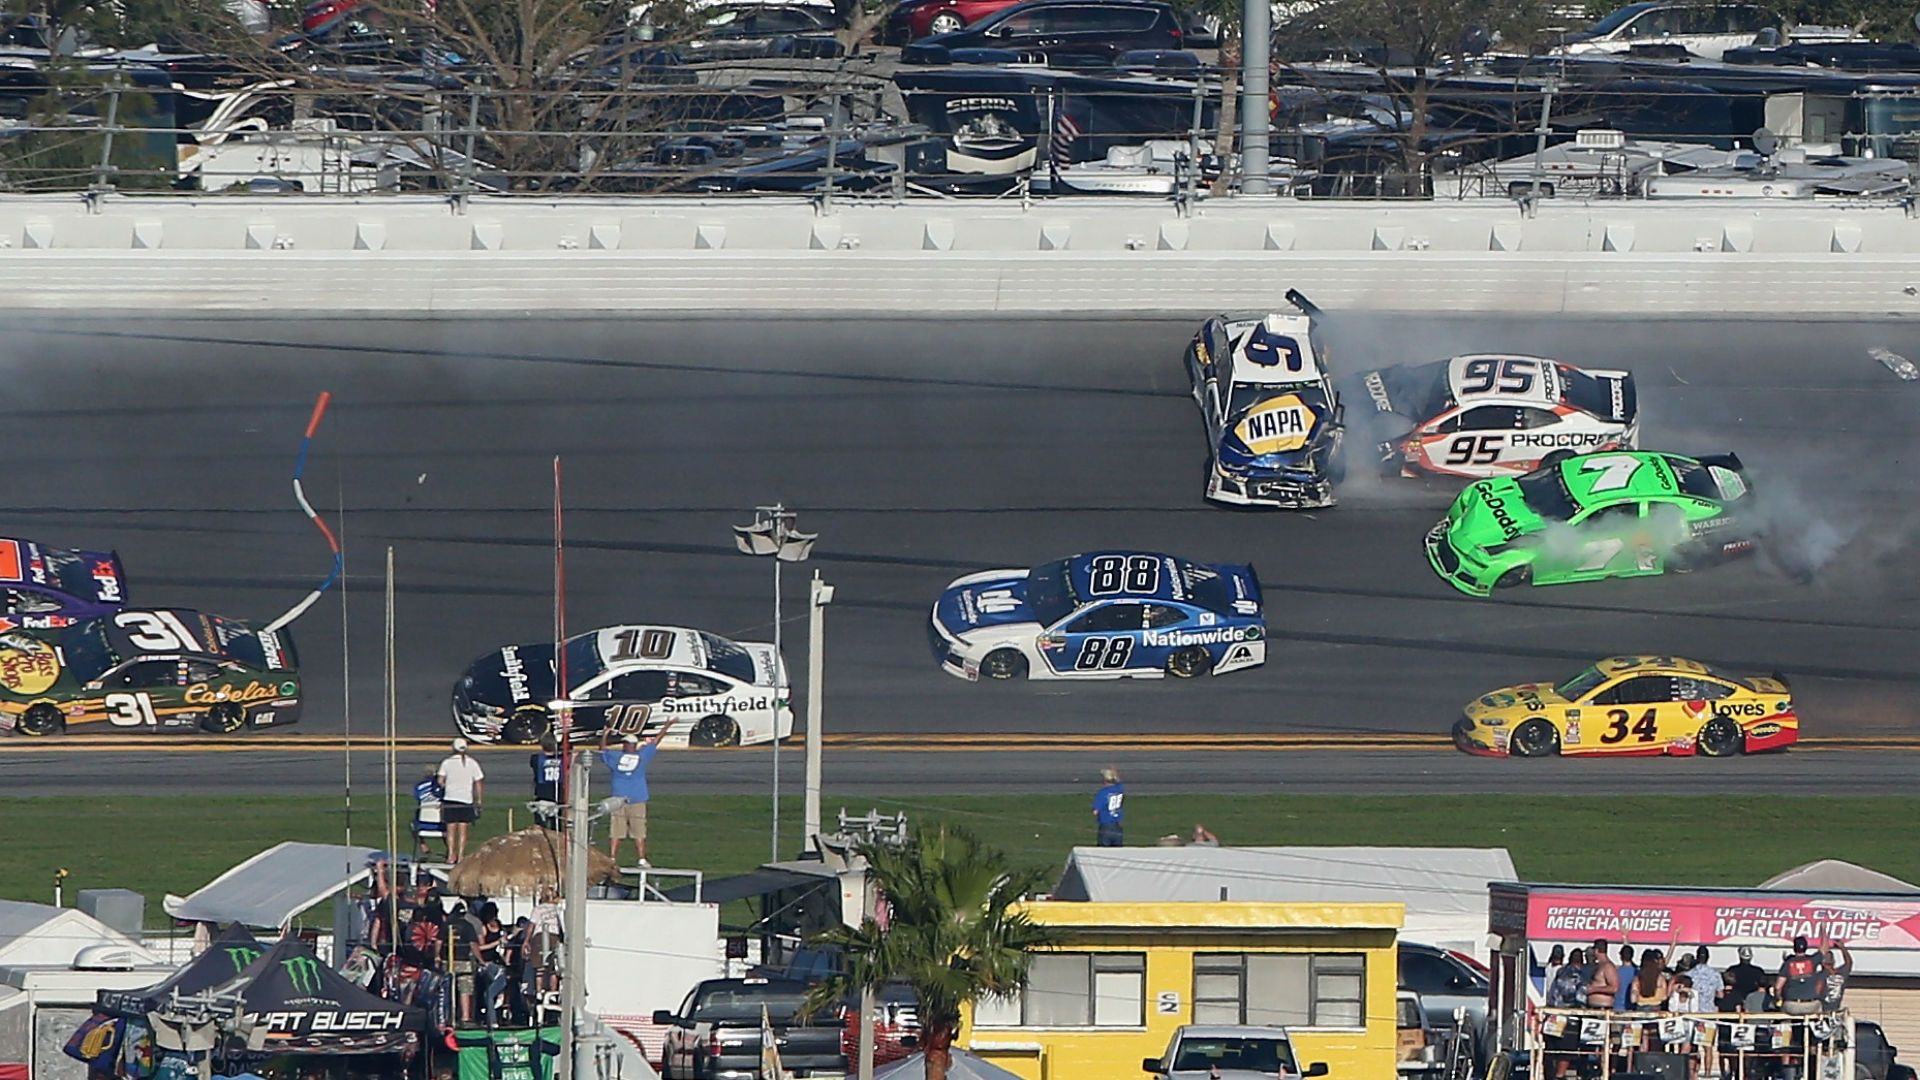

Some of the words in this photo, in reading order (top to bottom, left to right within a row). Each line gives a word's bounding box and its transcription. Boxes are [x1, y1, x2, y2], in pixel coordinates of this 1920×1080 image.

[946, 97, 1019, 114] SIERRA
[1462, 359, 1536, 395] 95
[1248, 408, 1304, 441] NAPA
[1446, 435, 1505, 466] 95
[1580, 454, 1643, 495] 7
[1475, 481, 1523, 542] GoDaddy
[1575, 536, 1623, 573] 7
[91, 560, 122, 602] FedEx
[1089, 554, 1161, 596] 88
[22, 615, 69, 629] FedEx
[113, 610, 204, 653] 31
[610, 628, 678, 664] 10
[1142, 626, 1245, 647] Nationwide
[16, 653, 36, 674] Pro
[34, 652, 55, 677] Bass
[1074, 634, 1135, 671] 88
[0, 656, 24, 690] Shops
[499, 644, 531, 704] Smithfield
[183, 680, 279, 704] Cabela's
[105, 691, 158, 727] 31
[661, 695, 768, 715] Smithfield
[254, 712, 276, 725] CAT
[604, 702, 651, 736] 10
[1599, 707, 1659, 745] 34
[617, 753, 640, 773] 9
[1545, 914, 1672, 933] MERCHANDISE
[1546, 906, 1616, 918] OFFICIAL
[1618, 908, 1671, 919] EVENT
[1714, 906, 1804, 920] OFFICIAL
[1812, 908, 1881, 922] EVENT
[1714, 918, 1881, 940] MERCHANDISE
[1159, 1001, 1178, 1013] 2
[310, 1011, 404, 1031] BUSCH
[1583, 1021, 1600, 1036] 2
[1663, 1019, 1677, 1034] 2
[1733, 1026, 1750, 1039] 2
